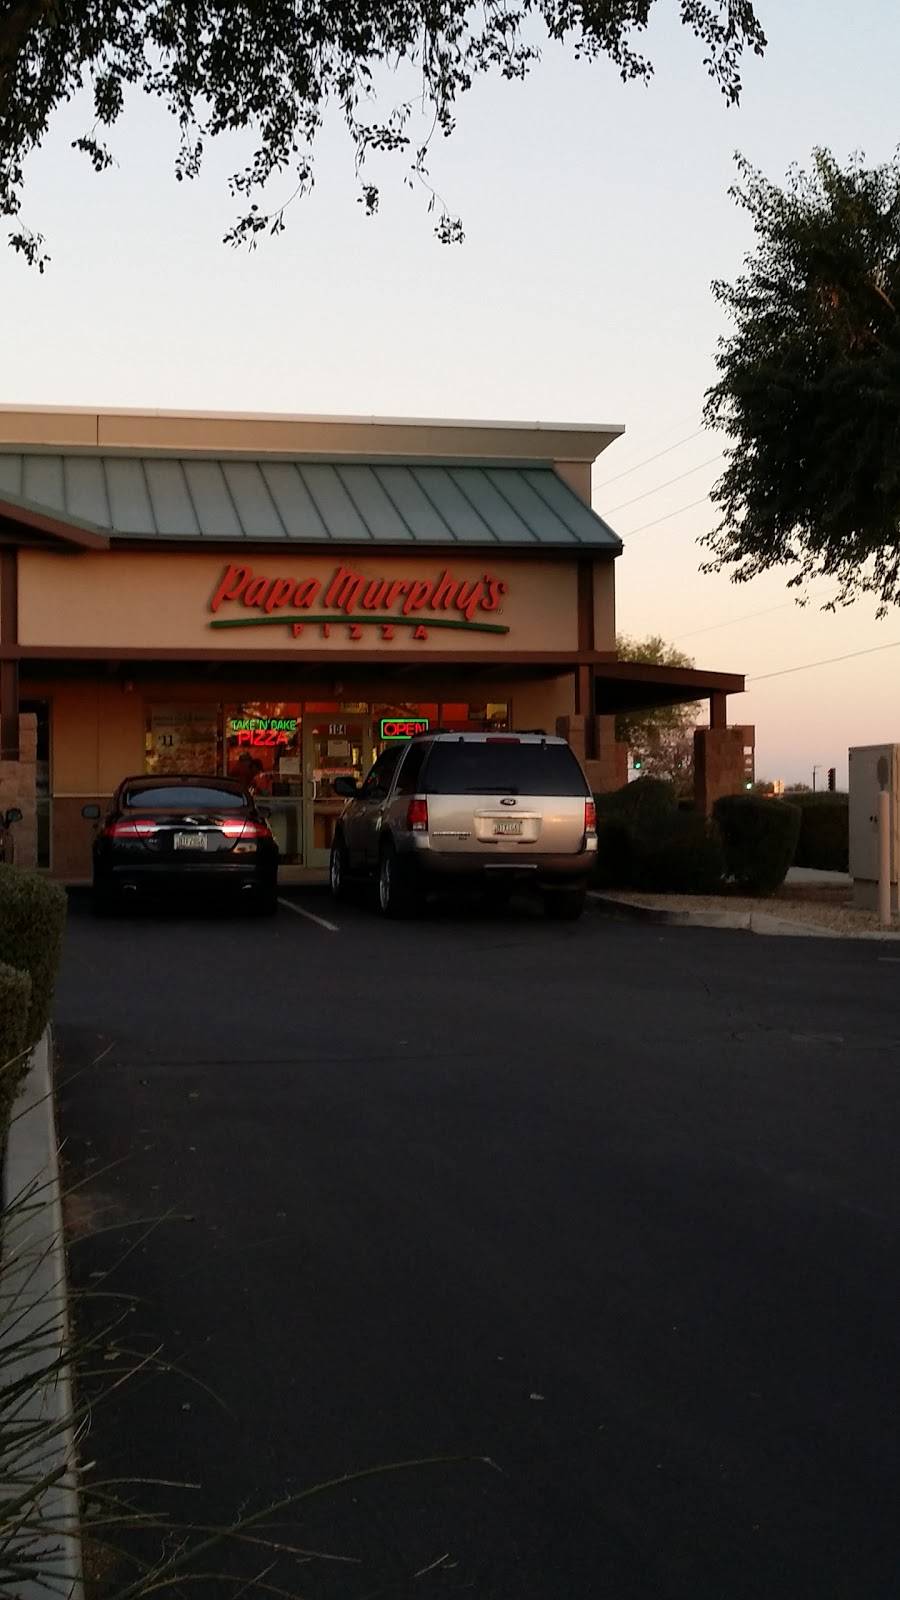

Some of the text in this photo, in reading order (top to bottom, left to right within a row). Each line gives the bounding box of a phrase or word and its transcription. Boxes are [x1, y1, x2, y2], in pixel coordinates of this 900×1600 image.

[210, 564, 507, 621] Papa Murphy's
[291, 622, 428, 641] PIZZA
[231, 719, 256, 731] TAKE
[270, 719, 297, 731] BAKE
[383, 722, 426, 736] OPEN
[237, 730, 289, 746] PIZZA
